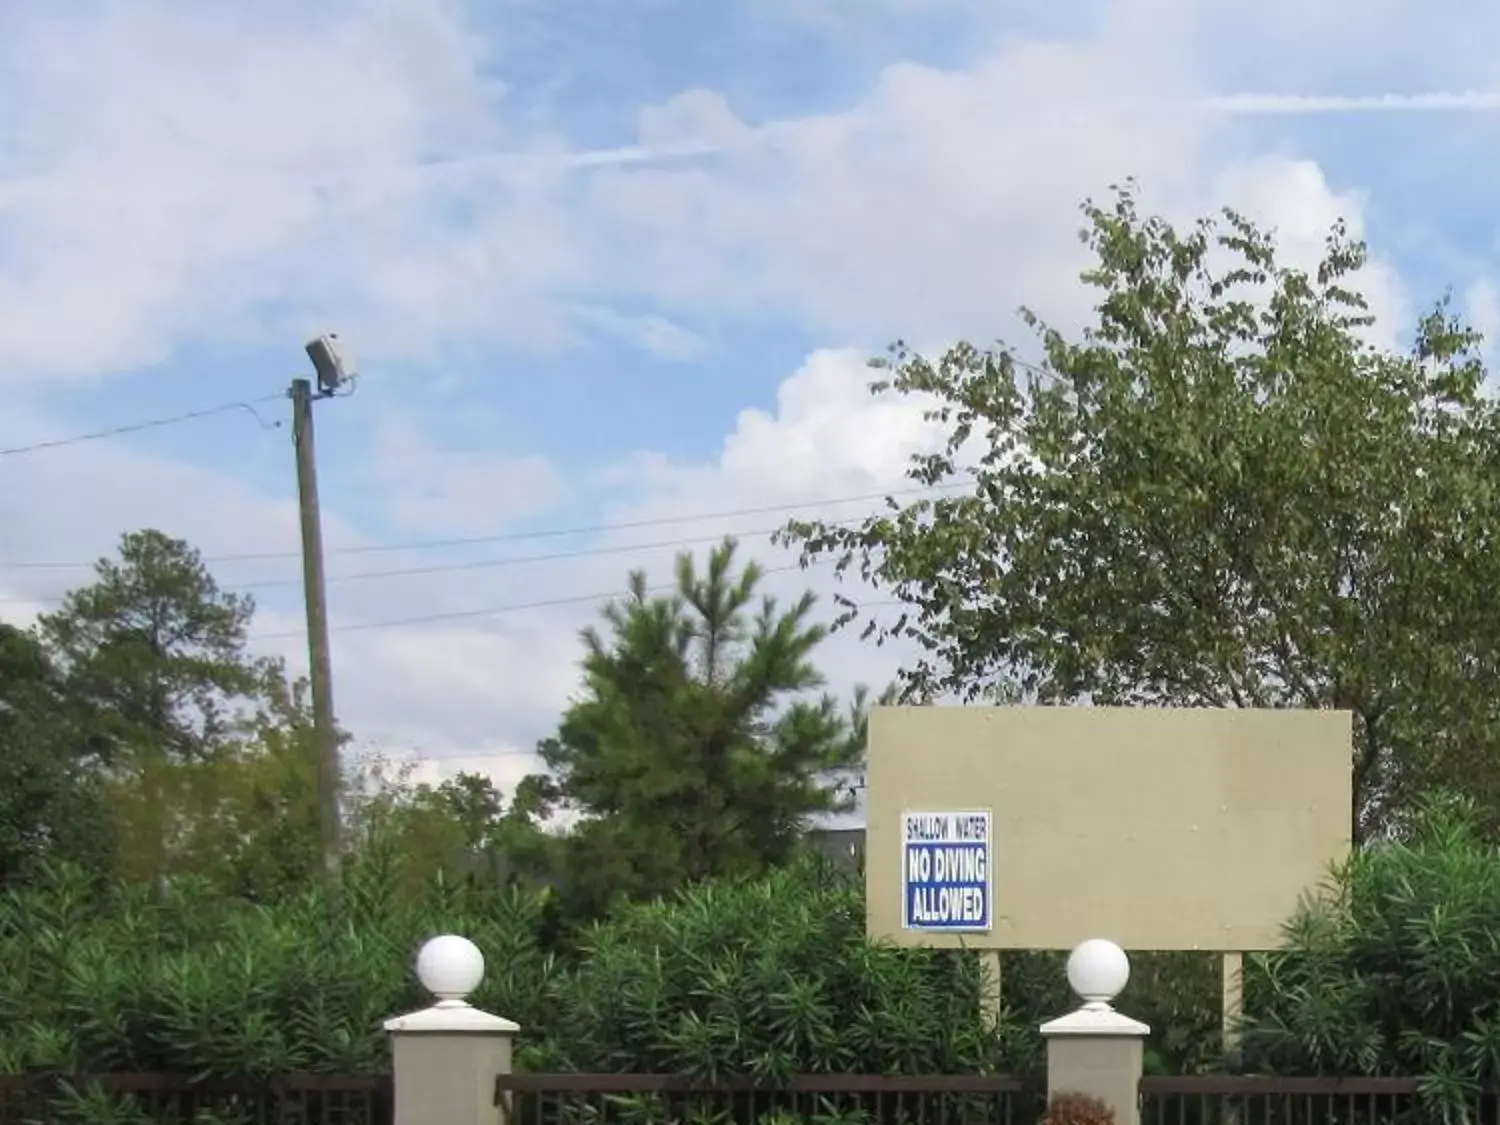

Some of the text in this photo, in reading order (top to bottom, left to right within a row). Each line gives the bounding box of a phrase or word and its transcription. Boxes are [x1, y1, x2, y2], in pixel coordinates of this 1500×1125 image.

[907, 816, 986, 840] SHALLOW WATER
[909, 847, 985, 882] NO DIVING
[913, 887, 983, 921] ALLOWED
